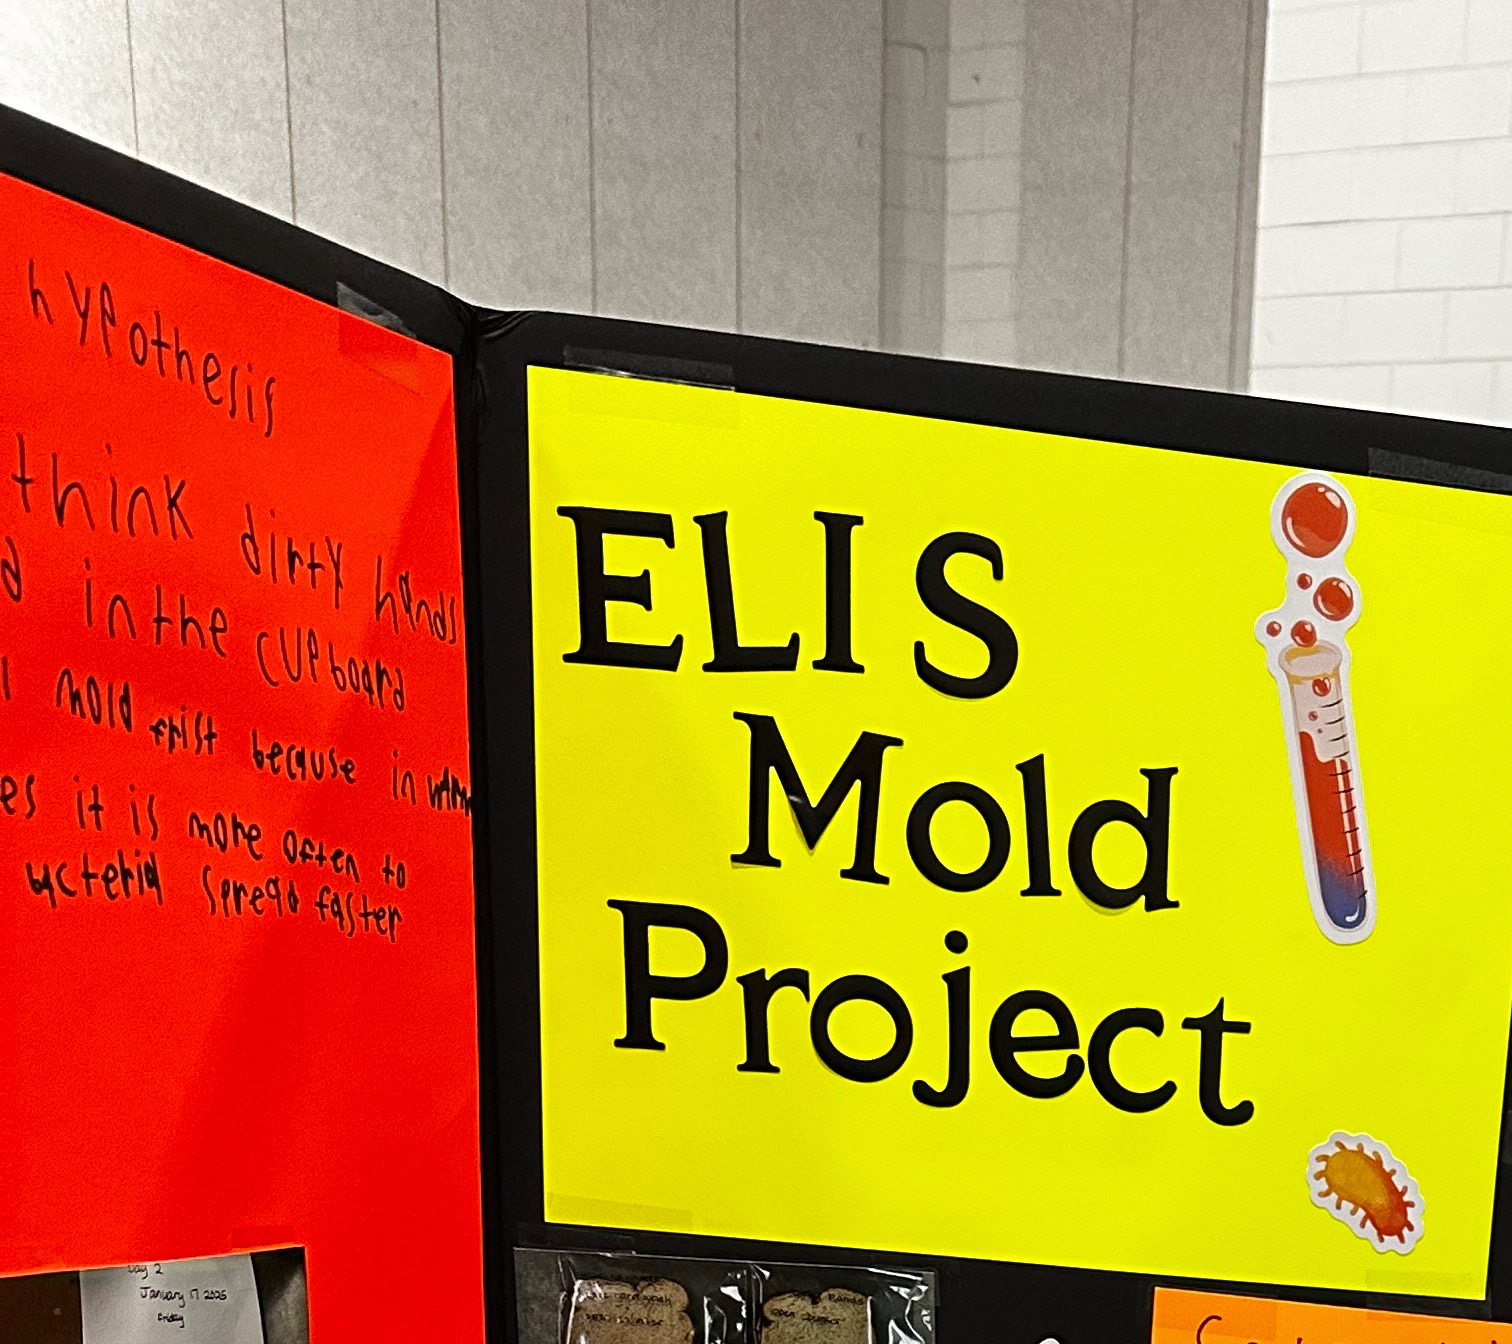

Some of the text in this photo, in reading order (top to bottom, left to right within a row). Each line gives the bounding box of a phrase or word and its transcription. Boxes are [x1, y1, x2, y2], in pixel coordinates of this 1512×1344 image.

[11, 434, 457, 645] think dirty hands
[73, 776, 104, 832] it
[129, 784, 159, 842] is
[188, 812, 263, 861] more
[252, 730, 356, 785] because
[392, 749, 417, 806] in
[730, 711, 1180, 913] Mold
[606, 897, 1255, 1127] Project
